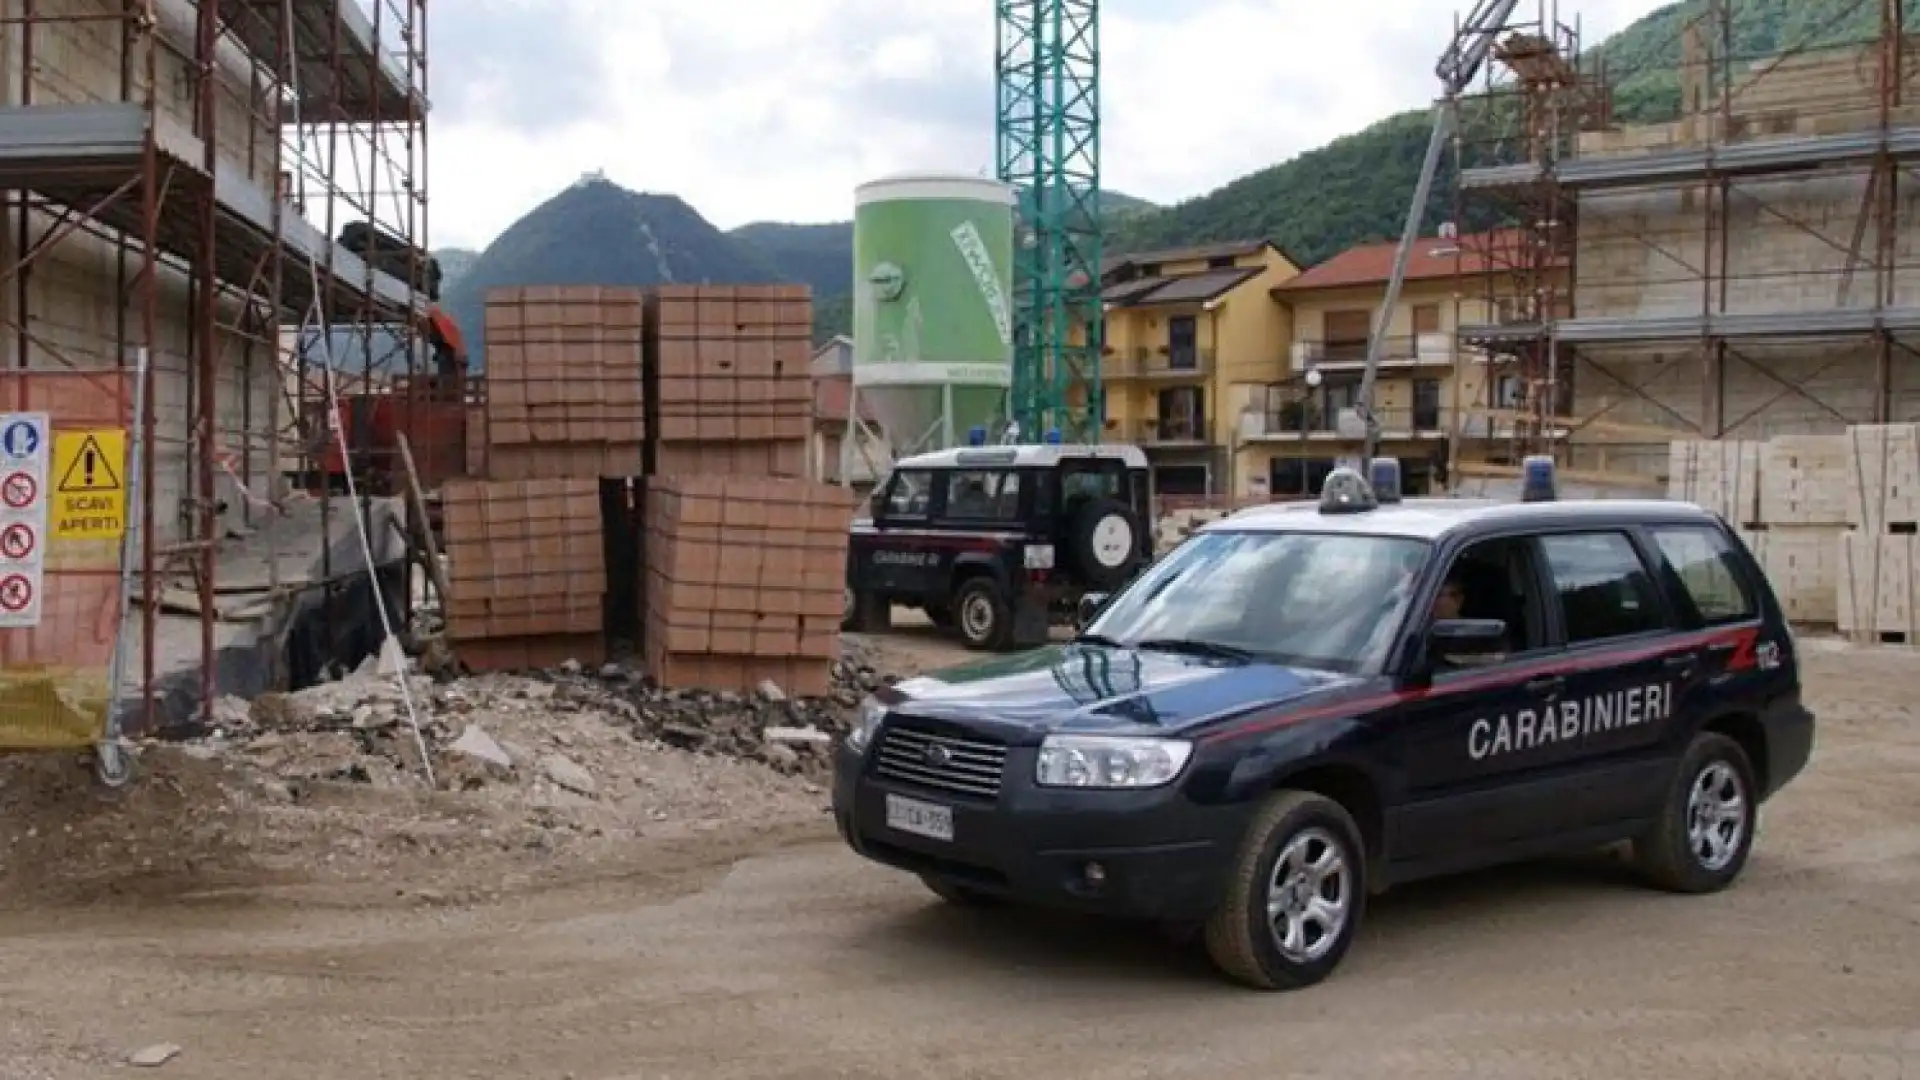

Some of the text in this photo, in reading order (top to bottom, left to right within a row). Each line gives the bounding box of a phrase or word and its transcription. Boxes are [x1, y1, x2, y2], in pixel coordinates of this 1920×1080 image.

[65, 495, 114, 512] SCAVI
[58, 516, 119, 533] APERTI
[1467, 682, 1672, 760] CARABINIERI
